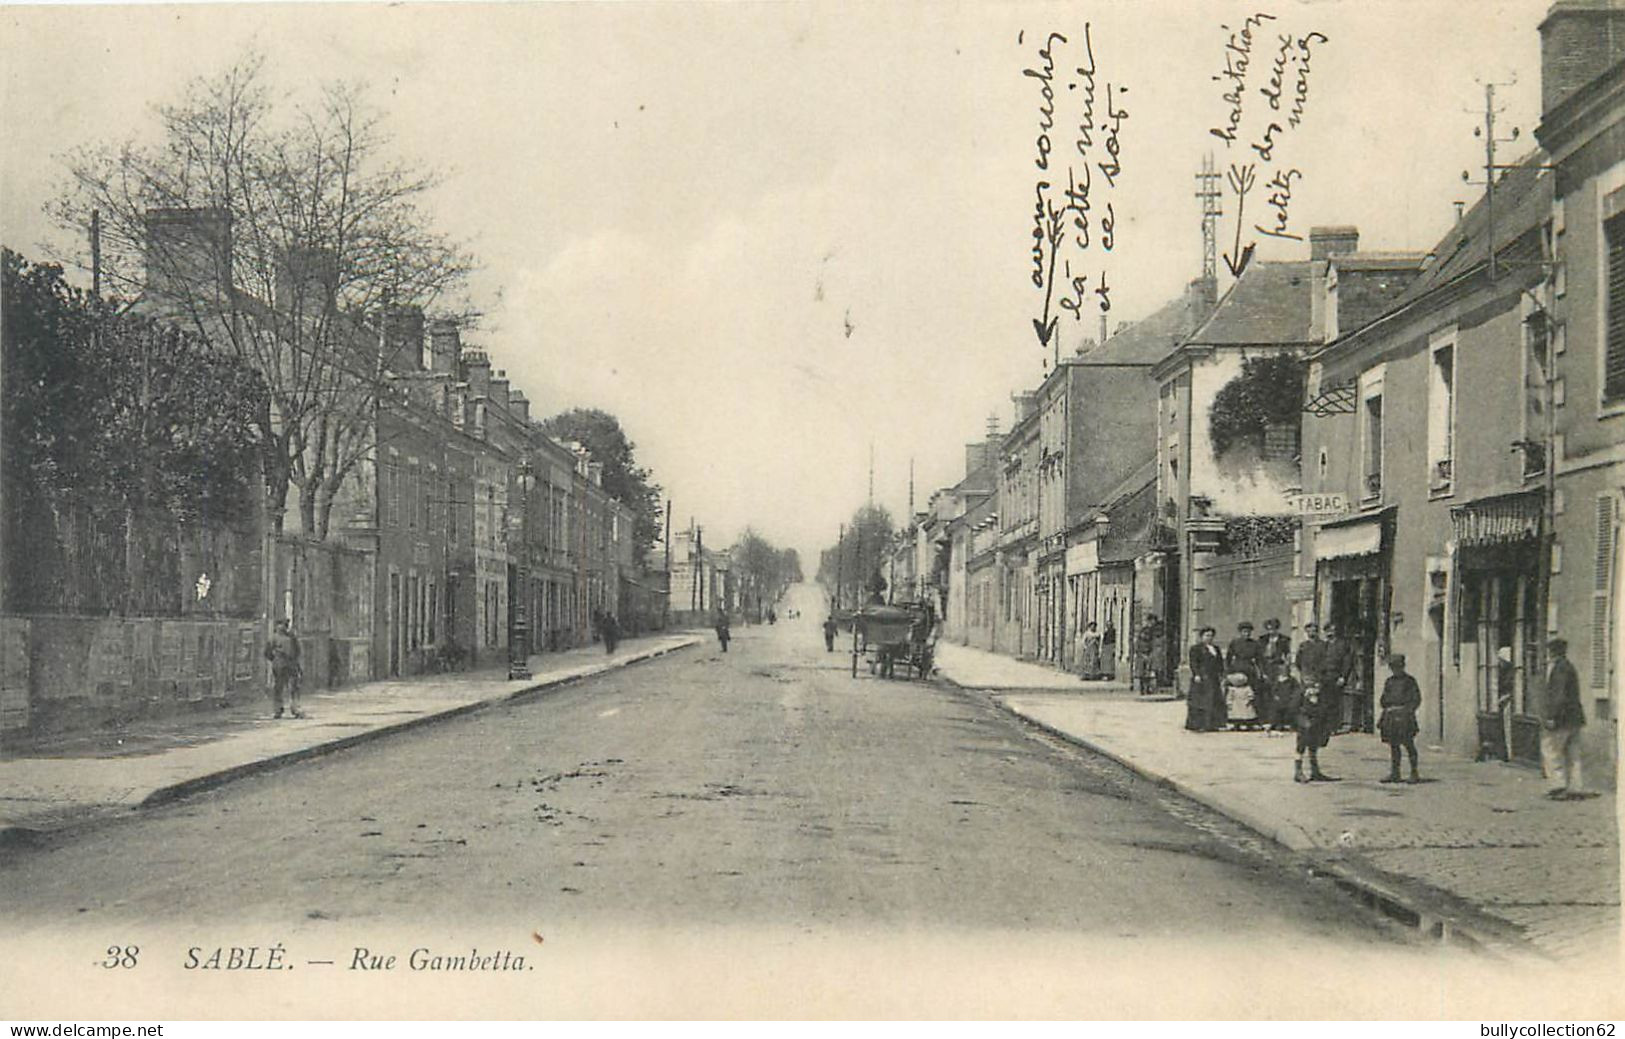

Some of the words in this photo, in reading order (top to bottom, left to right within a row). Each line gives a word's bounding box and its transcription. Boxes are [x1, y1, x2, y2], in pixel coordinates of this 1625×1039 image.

[1069, 22, 1095, 157] nuit
[1210, 12, 1277, 148] habitation
[1260, 34, 1293, 110] deux
[1025, 181, 1050, 288] avons
[1066, 163, 1092, 250] cette
[1103, 203, 1116, 251] ce
[1255, 168, 1304, 241] petits
[1060, 260, 1086, 320] là
[1095, 270, 1112, 312] et
[1297, 496, 1342, 511] TABAC
[102, 945, 140, 970] 38
[184, 942, 296, 971] SABLÉ.
[349, 947, 397, 971] Rue
[409, 946, 535, 971] Gambetta.
